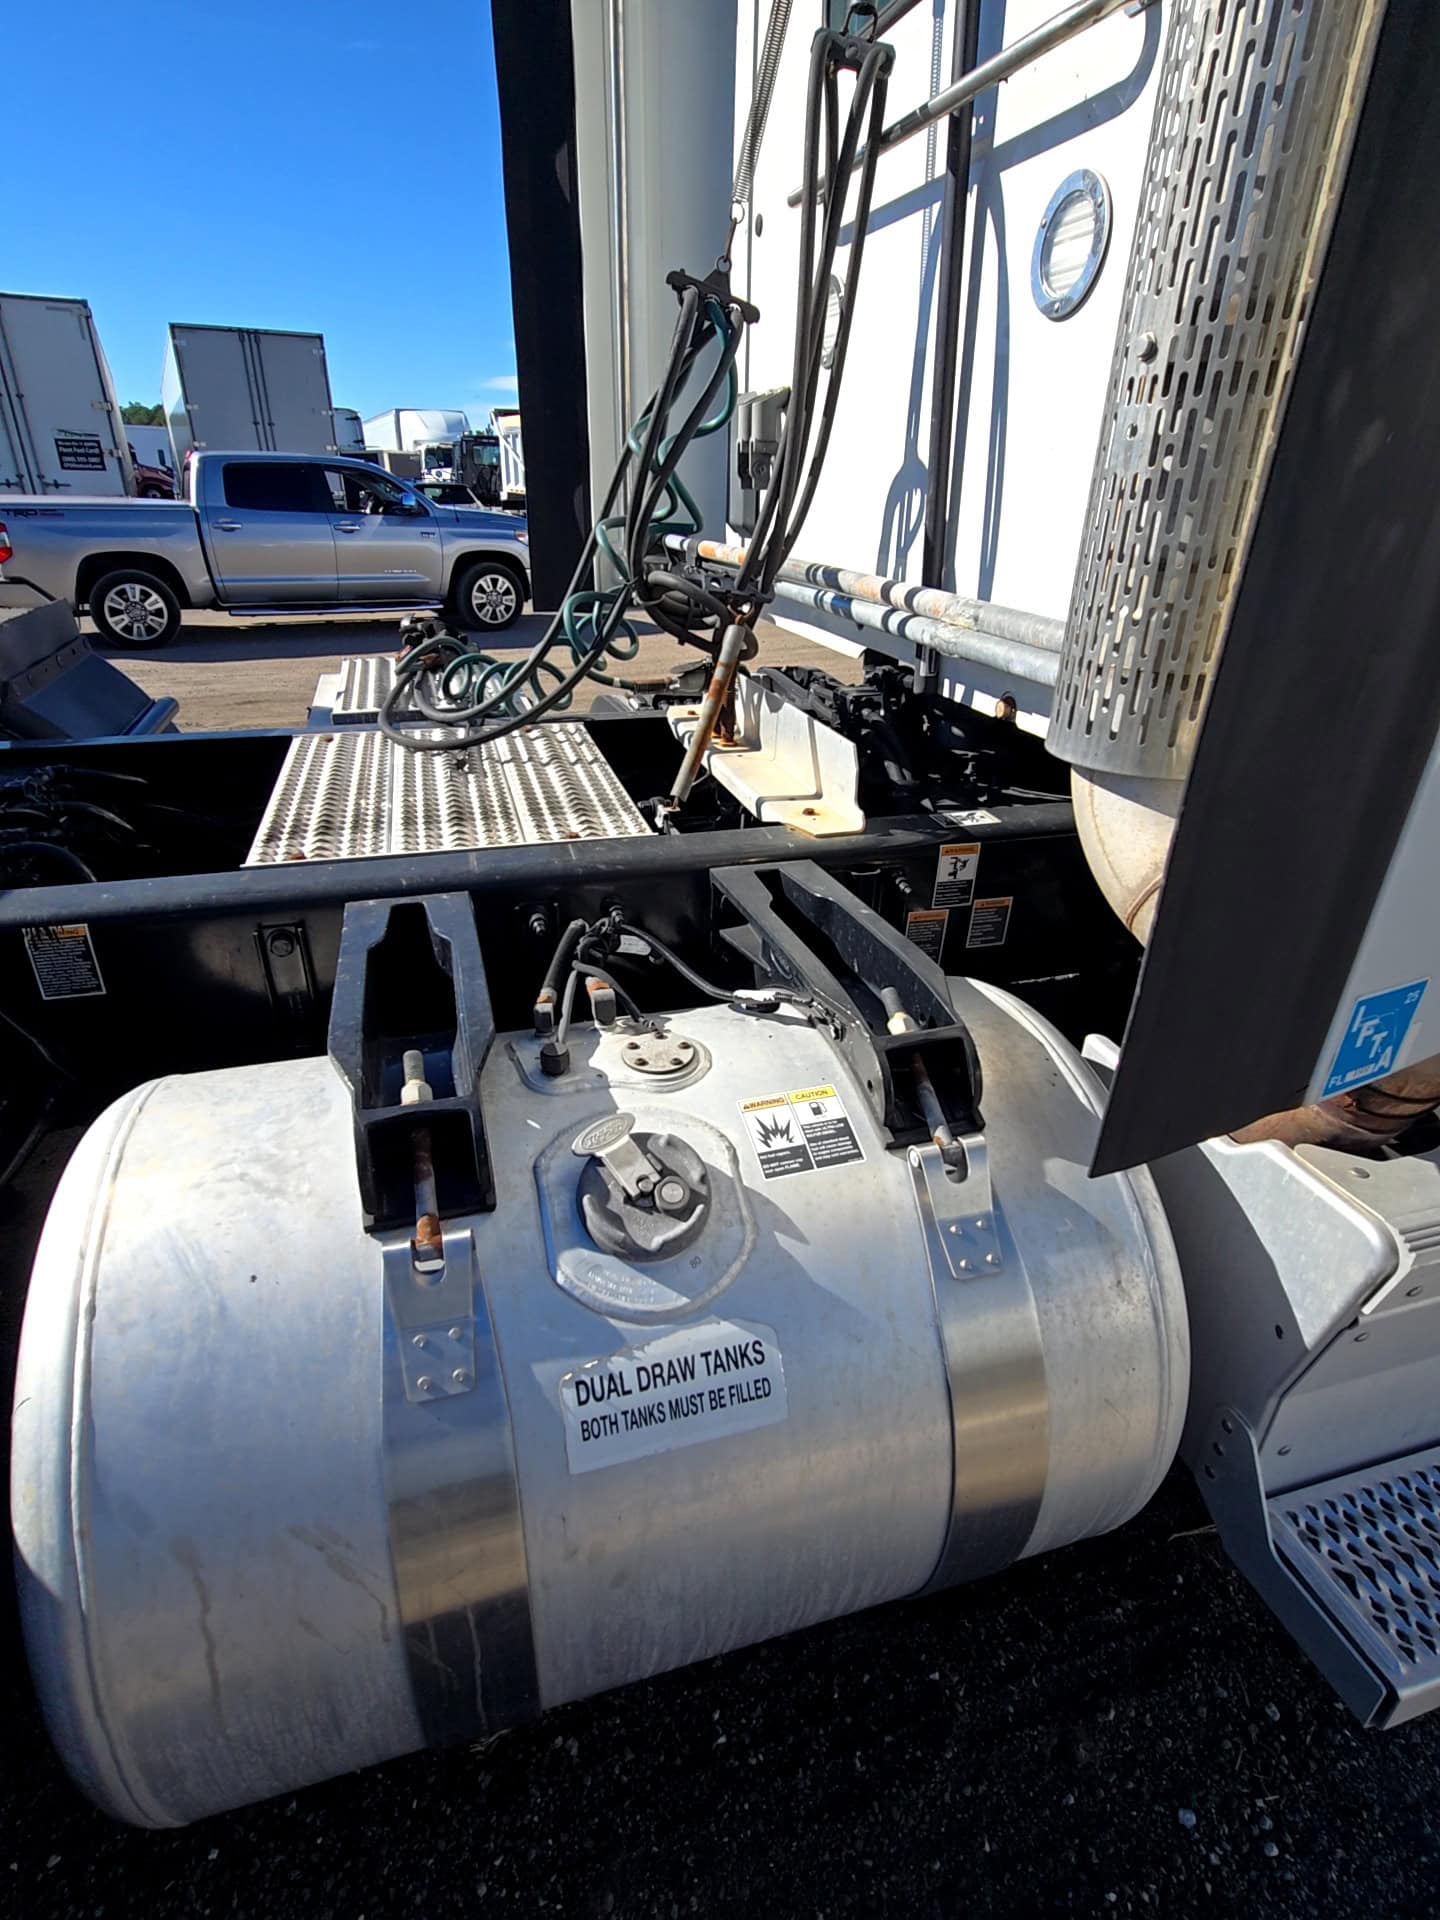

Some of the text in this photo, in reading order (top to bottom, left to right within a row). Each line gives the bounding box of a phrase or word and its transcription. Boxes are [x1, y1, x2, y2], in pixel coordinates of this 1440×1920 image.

[749, 1096, 785, 1109] WARNING
[795, 1089, 829, 1100] CAUTION
[574, 1339, 766, 1407] DUAL DRAW TANKS
[580, 1377, 772, 1442] BOTH TANKS MUST BE FILLED
